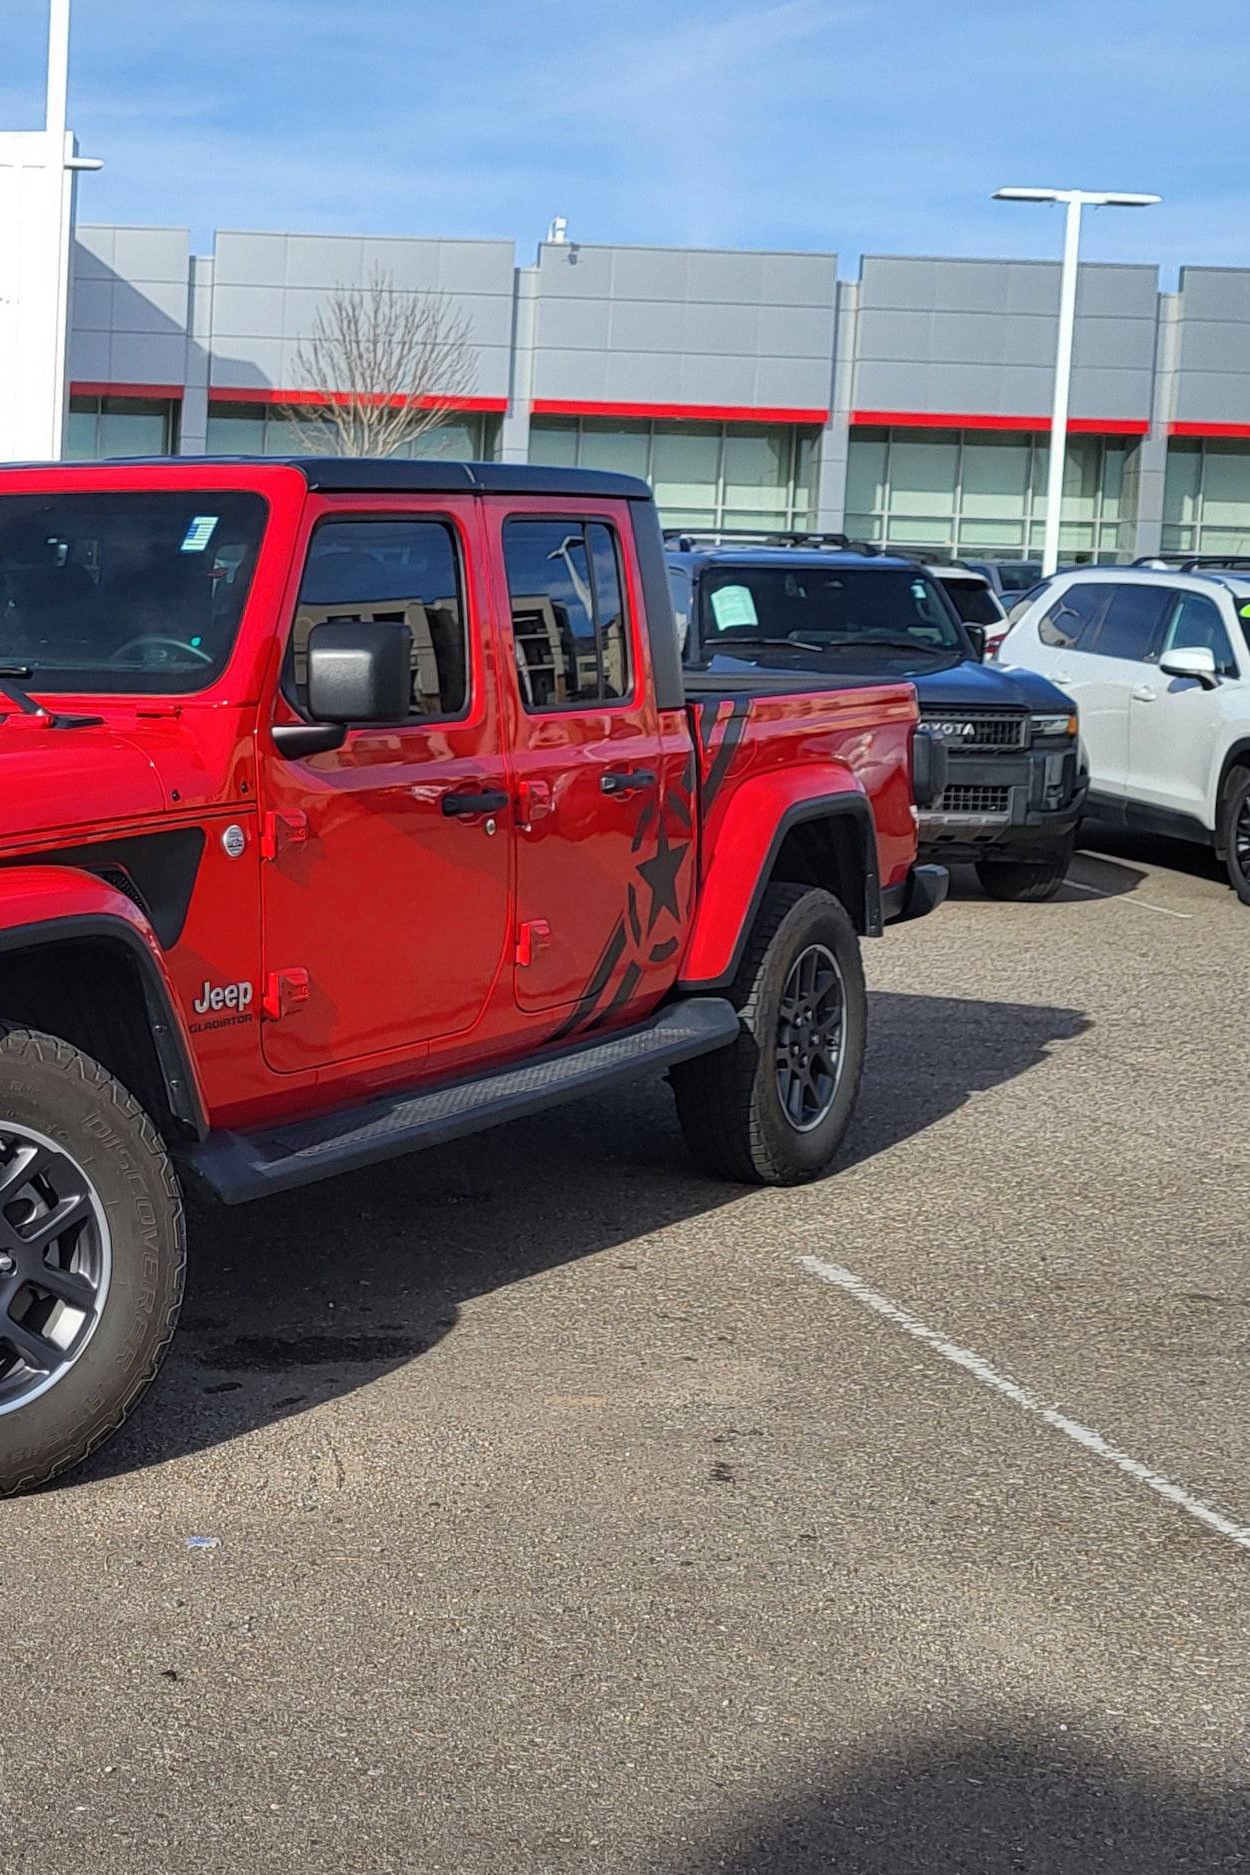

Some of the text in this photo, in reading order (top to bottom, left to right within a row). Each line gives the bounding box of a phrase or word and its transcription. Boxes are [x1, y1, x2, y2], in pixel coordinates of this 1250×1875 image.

[917, 723, 976, 735] OYOTA
[194, 981, 253, 1014] Jeep
[189, 1014, 253, 1034] GLADIATOR
